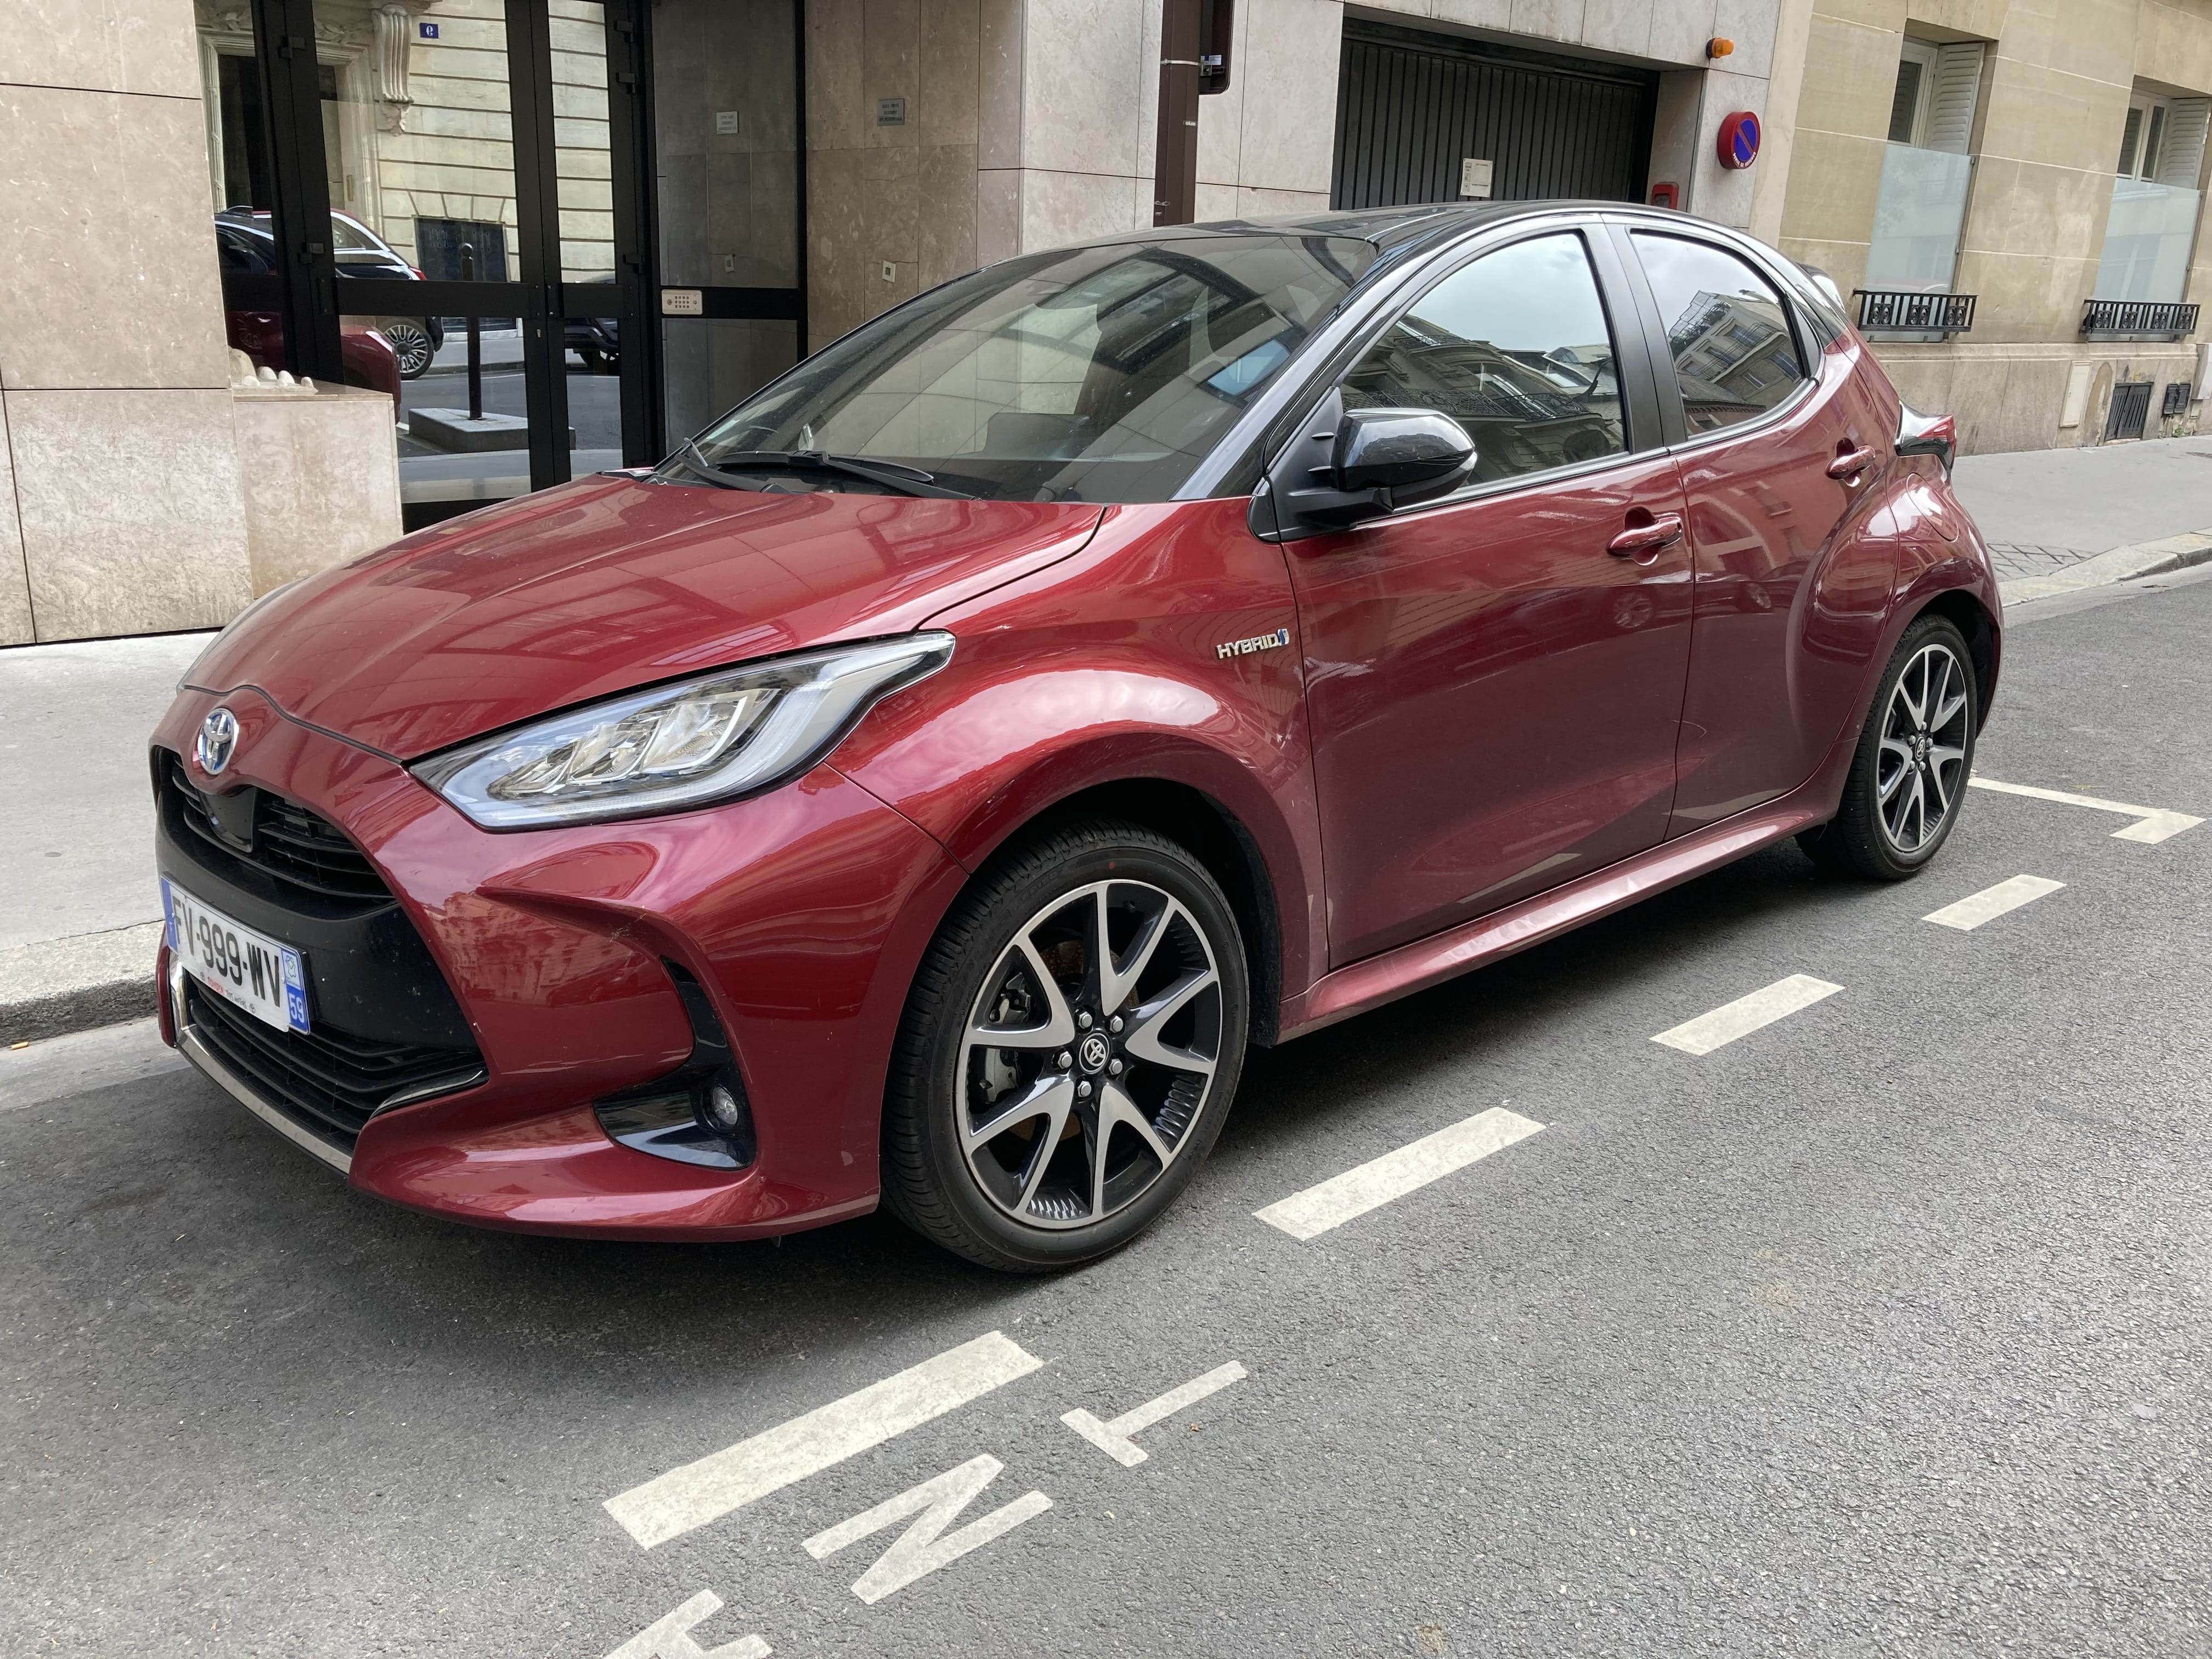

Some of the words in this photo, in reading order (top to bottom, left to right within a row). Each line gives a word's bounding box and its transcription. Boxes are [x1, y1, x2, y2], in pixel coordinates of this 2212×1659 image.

[1216, 633, 1281, 659] HYBRID
[172, 895, 280, 1008] FV-999-WV
[289, 992, 304, 1023] 59
